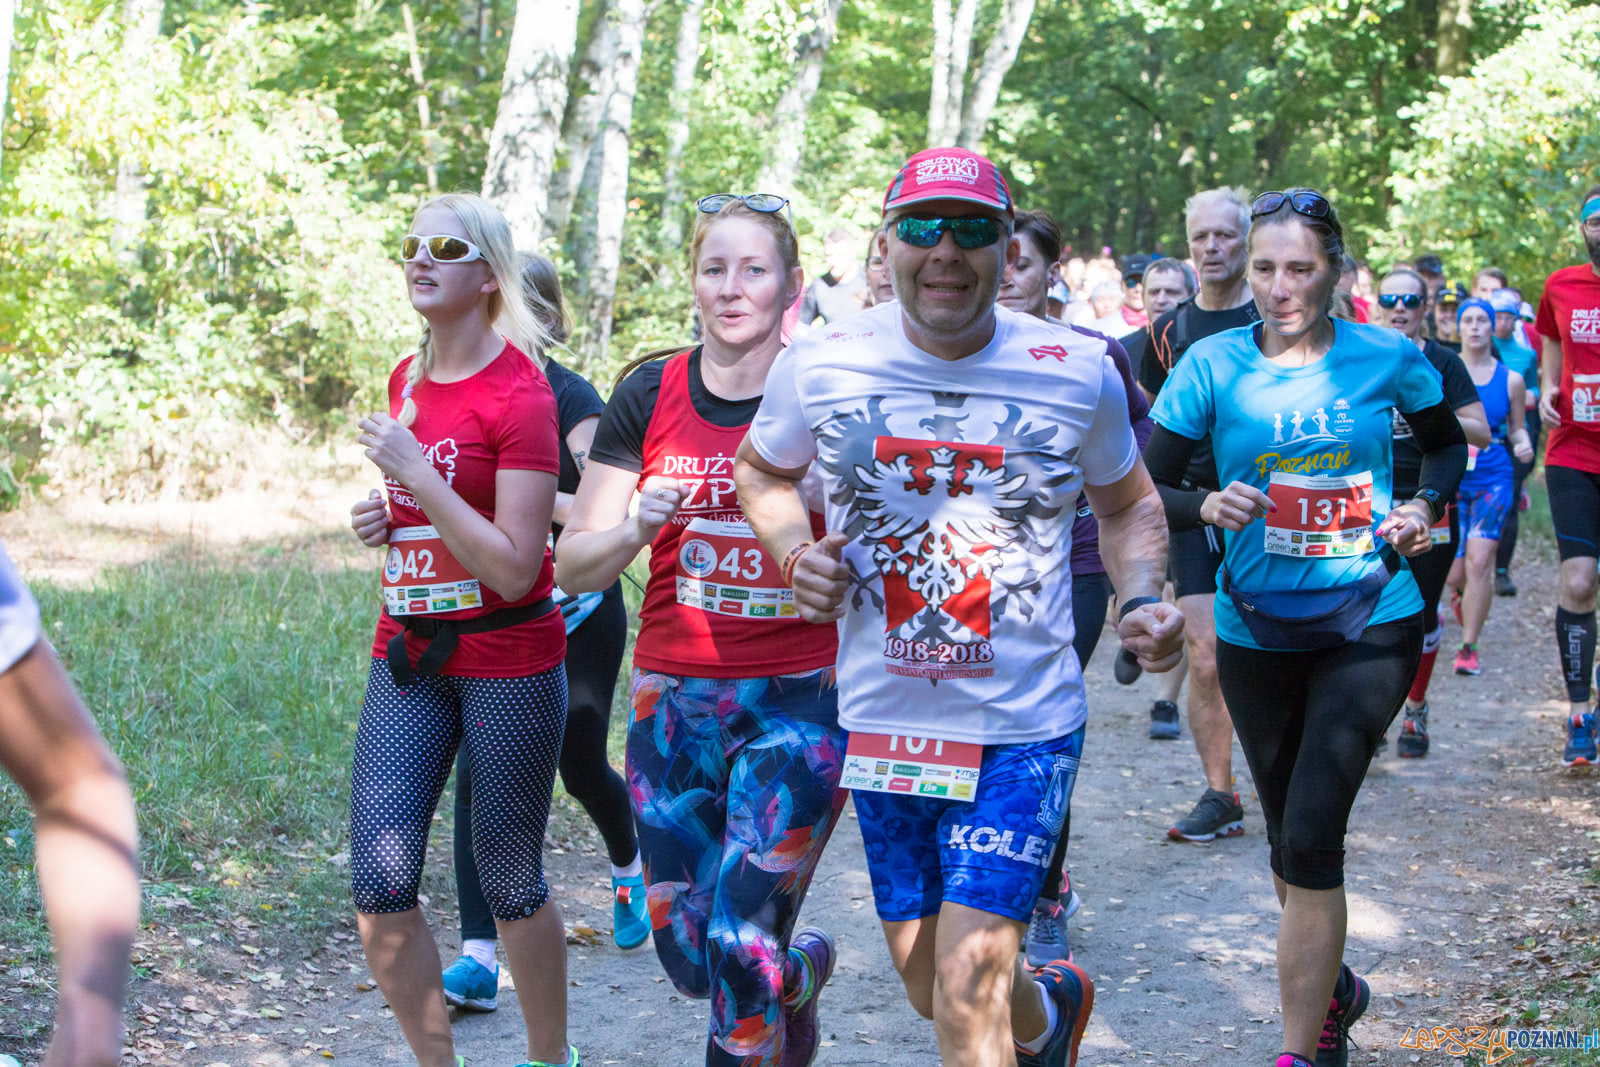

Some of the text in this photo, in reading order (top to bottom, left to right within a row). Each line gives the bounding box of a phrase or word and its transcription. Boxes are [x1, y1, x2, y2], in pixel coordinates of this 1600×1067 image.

[1570, 319, 1600, 335] SZP
[1255, 443, 1352, 479] Poznań
[1297, 498, 1347, 526] 131
[403, 548, 437, 579] 42
[718, 547, 763, 580] 43
[884, 637, 995, 664] 1918-2018
